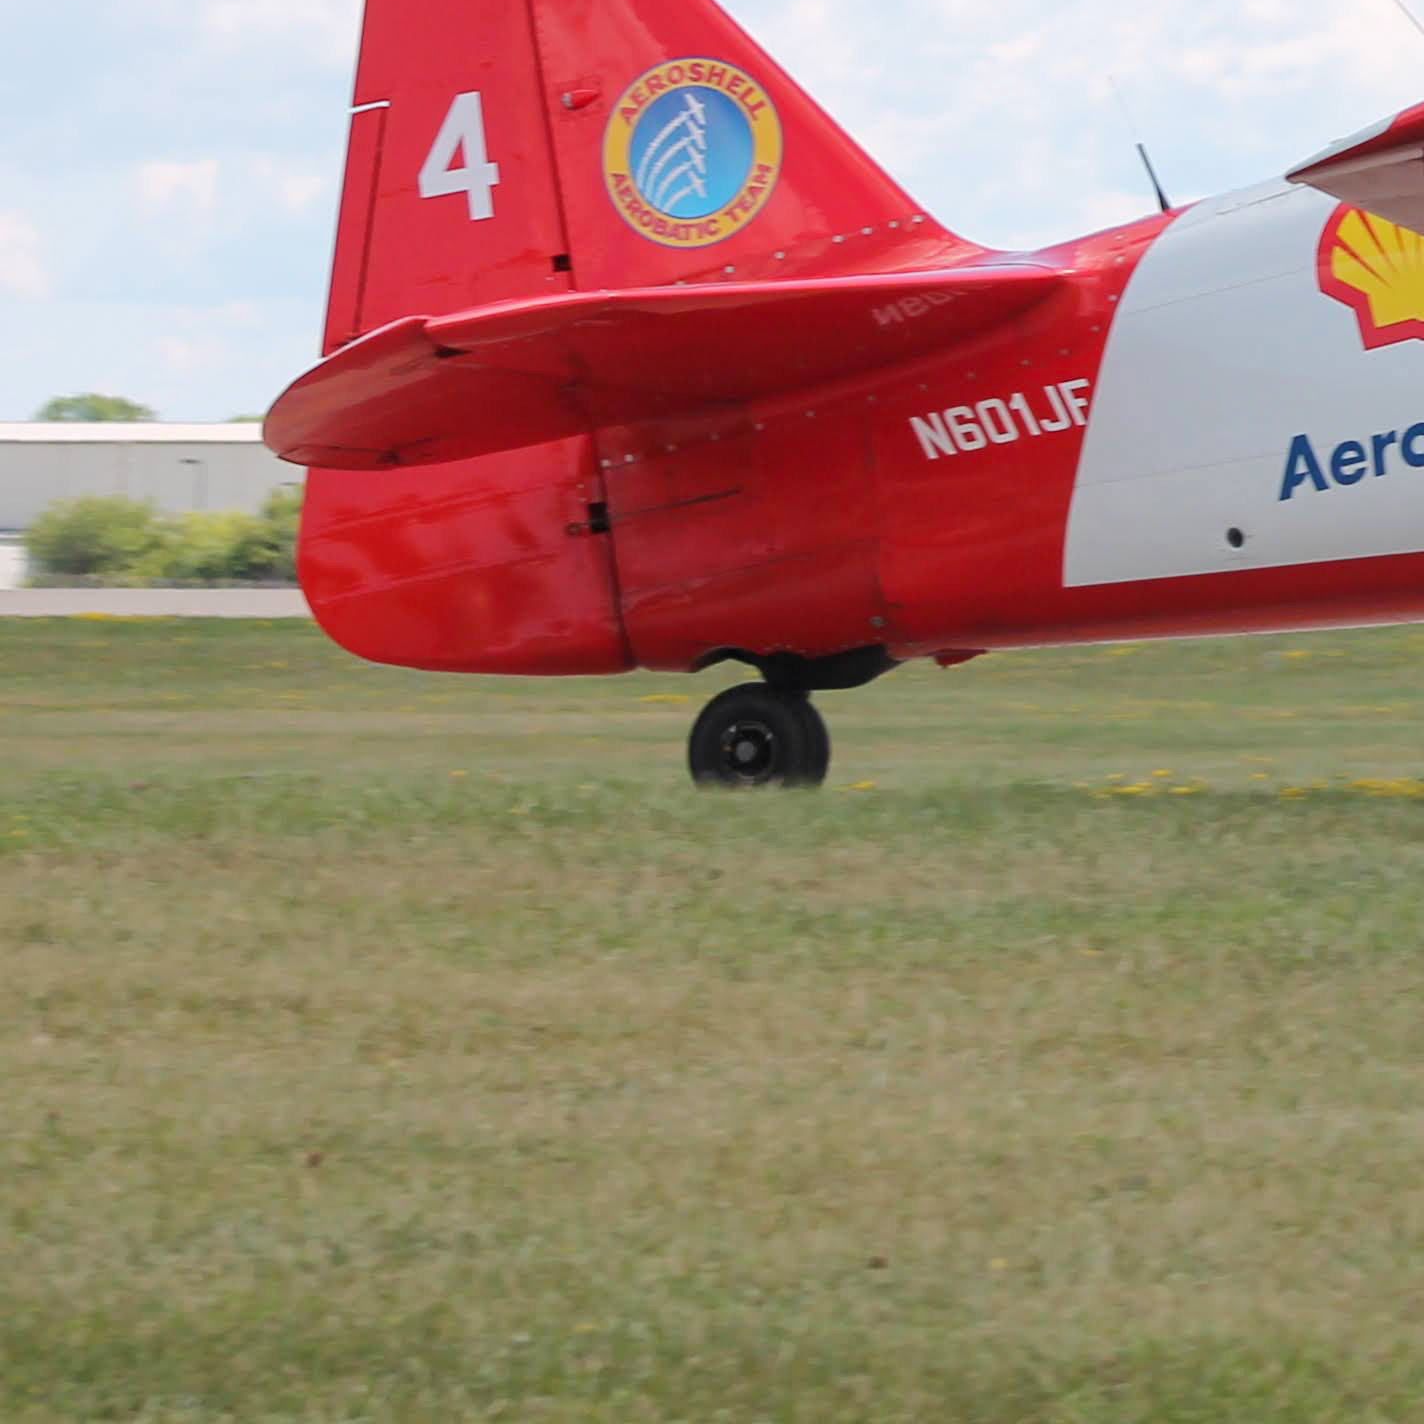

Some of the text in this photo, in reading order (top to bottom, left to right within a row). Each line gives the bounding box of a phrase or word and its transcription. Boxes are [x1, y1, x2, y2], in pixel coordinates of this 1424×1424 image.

[619, 62, 768, 125] AEROSHELL
[418, 91, 499, 221] 4
[611, 163, 773, 241] AEROBATIC TEAM
[908, 378, 1090, 460] N601JF
